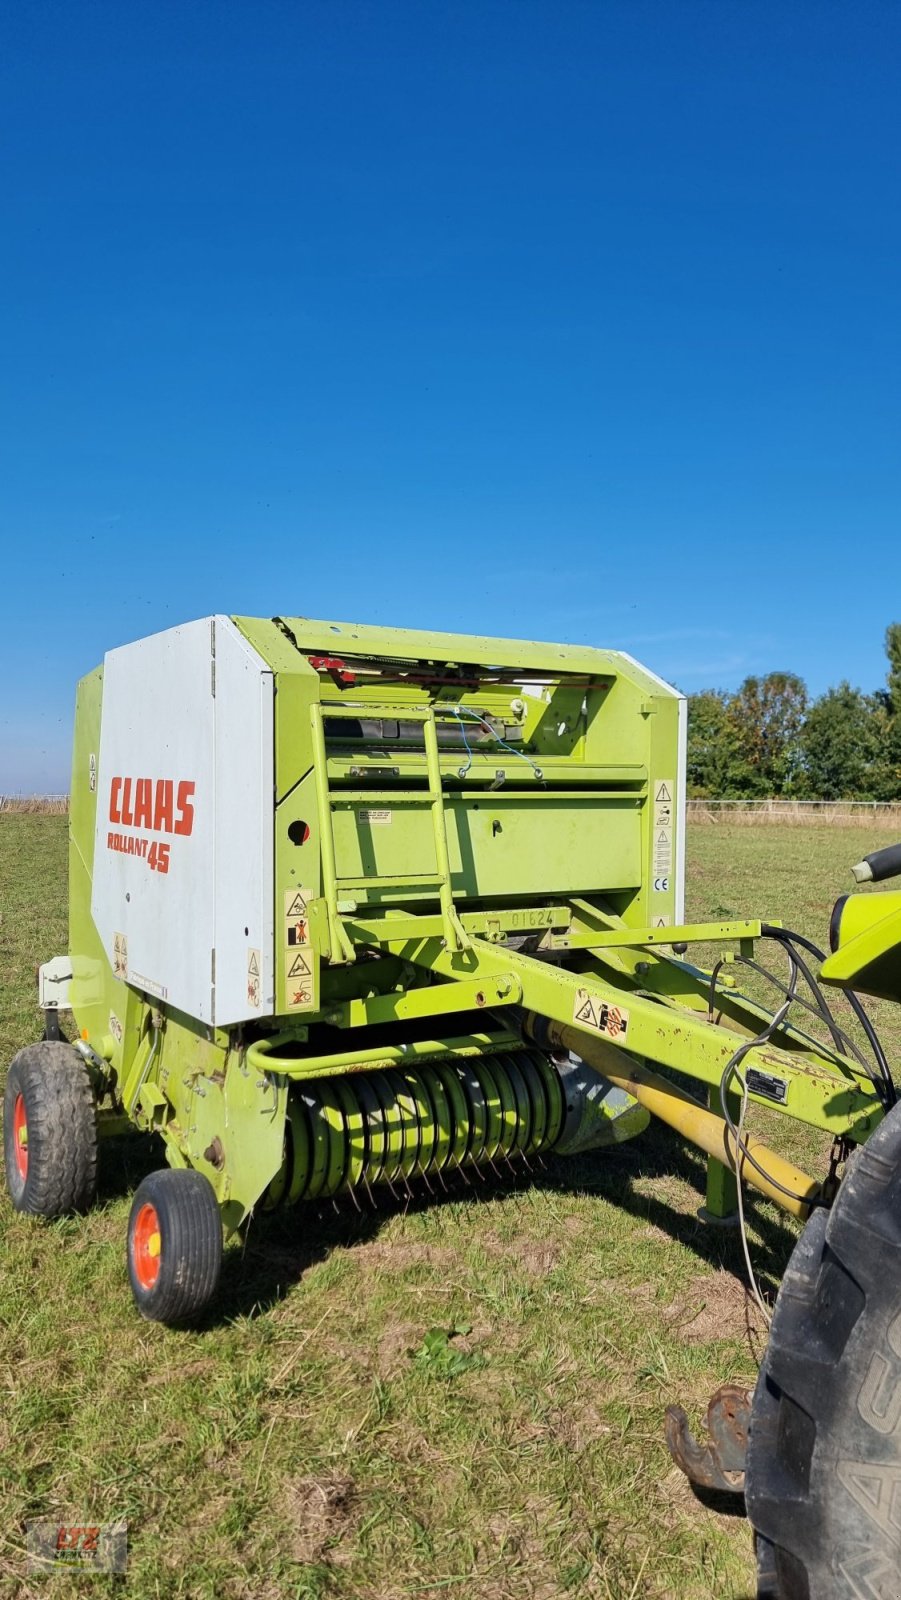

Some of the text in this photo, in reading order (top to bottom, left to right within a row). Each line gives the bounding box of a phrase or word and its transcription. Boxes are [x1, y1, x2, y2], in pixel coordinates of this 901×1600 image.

[109, 777, 195, 836] CLAAS
[107, 832, 170, 874] ROLLANT 45
[654, 878, 668, 891] CE
[511, 910, 552, 927] 01624
